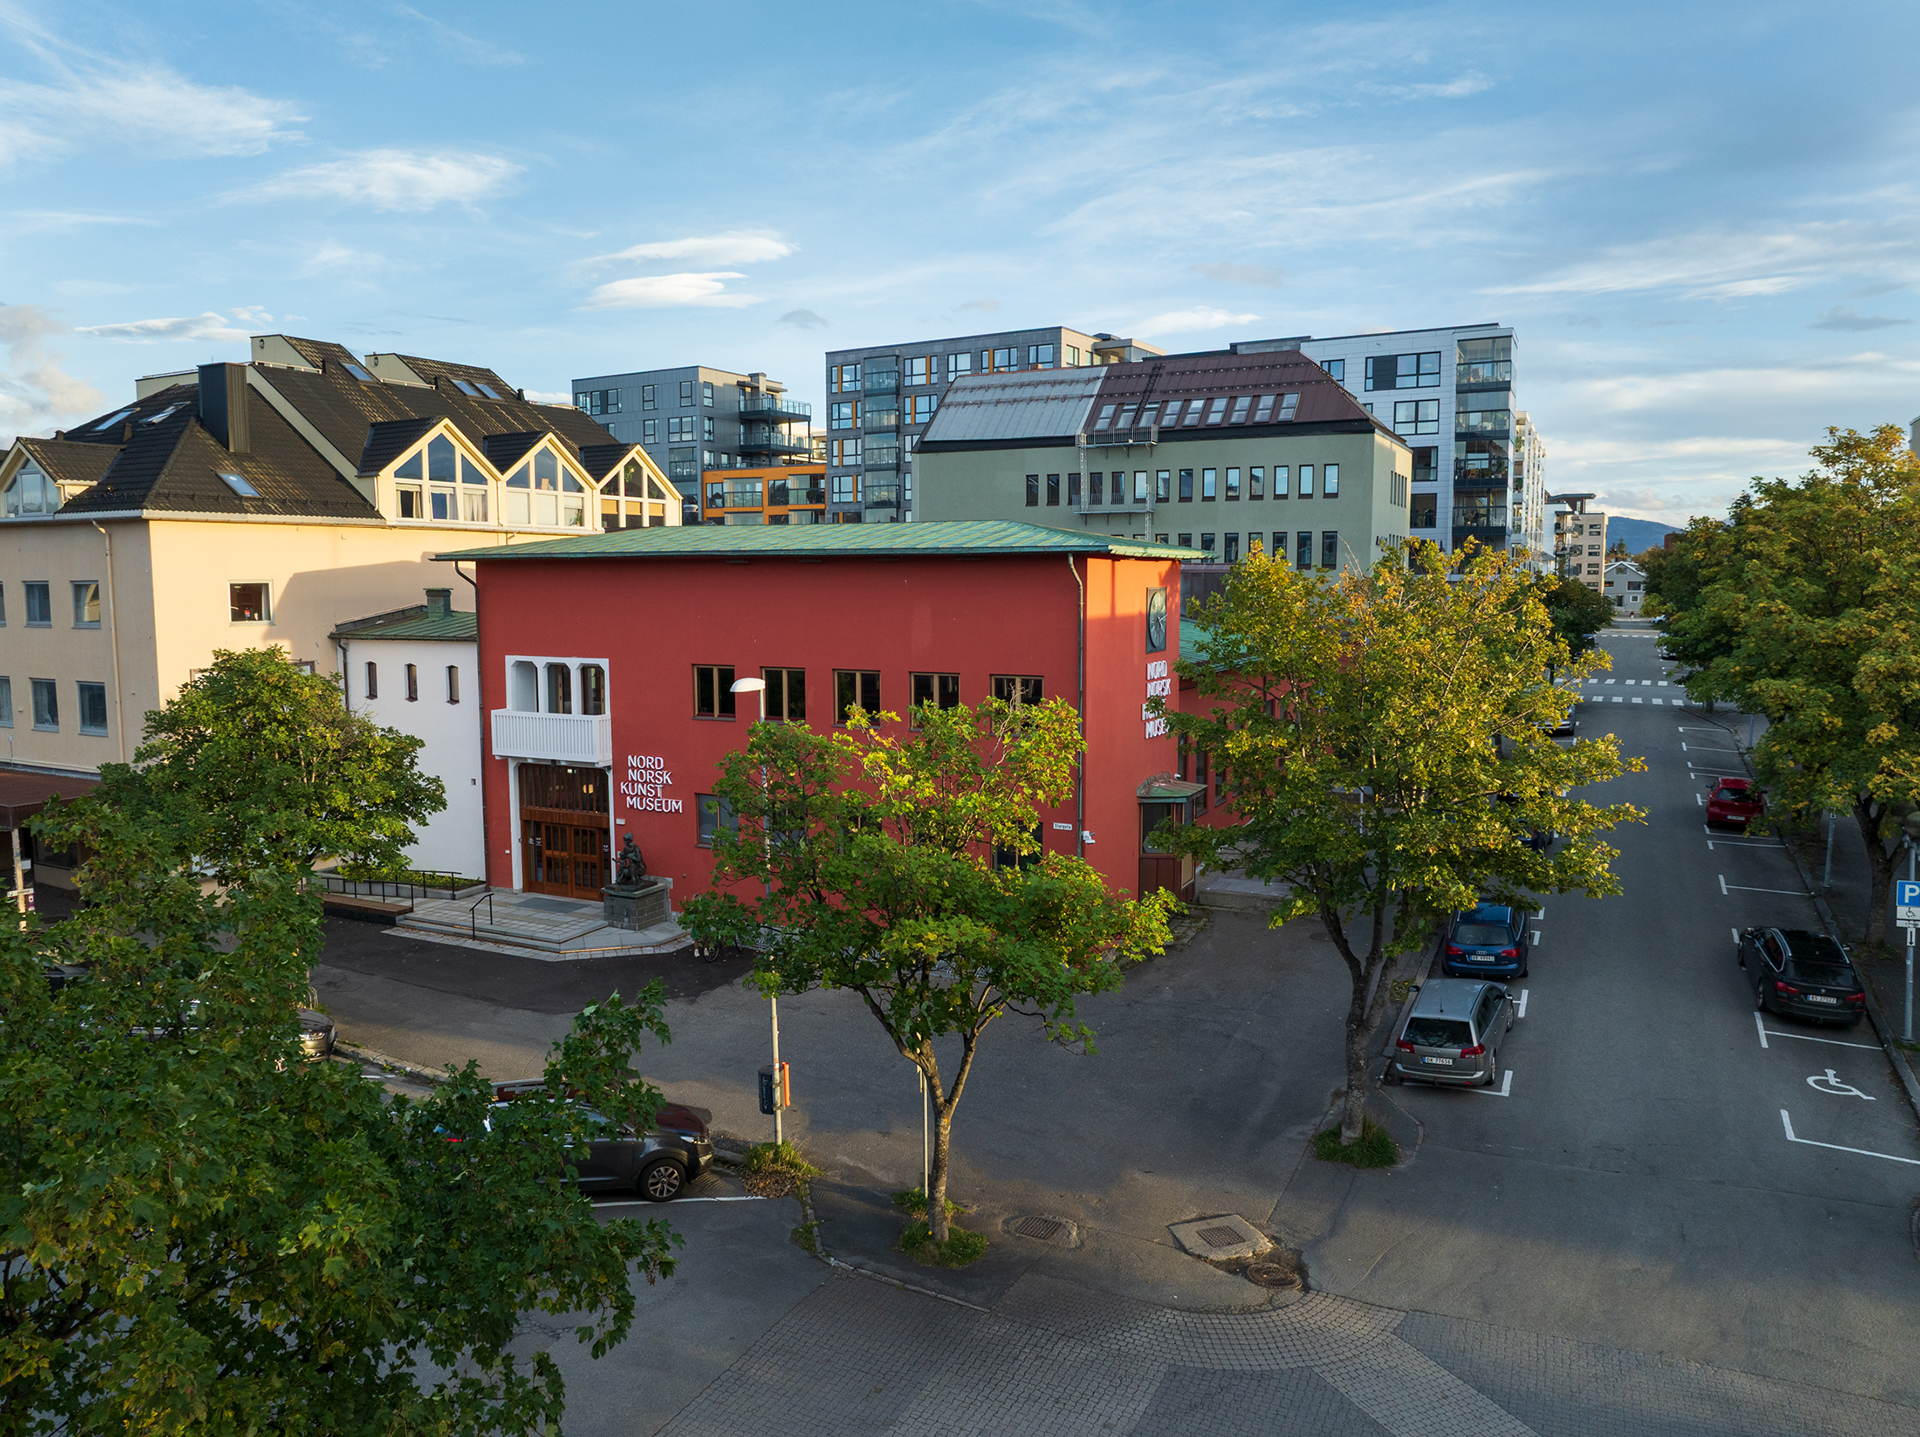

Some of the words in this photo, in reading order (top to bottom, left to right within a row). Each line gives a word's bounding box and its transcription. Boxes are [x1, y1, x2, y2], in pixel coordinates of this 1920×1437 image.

[1146, 660, 1168, 681] NORD
[1146, 679, 1171, 699] NORSK
[627, 755, 664, 770] NORD
[628, 769, 673, 785] NORSK
[620, 781, 664, 798] KUNST
[626, 796, 683, 814] MUSEUM
[1904, 884, 1919, 903] P
